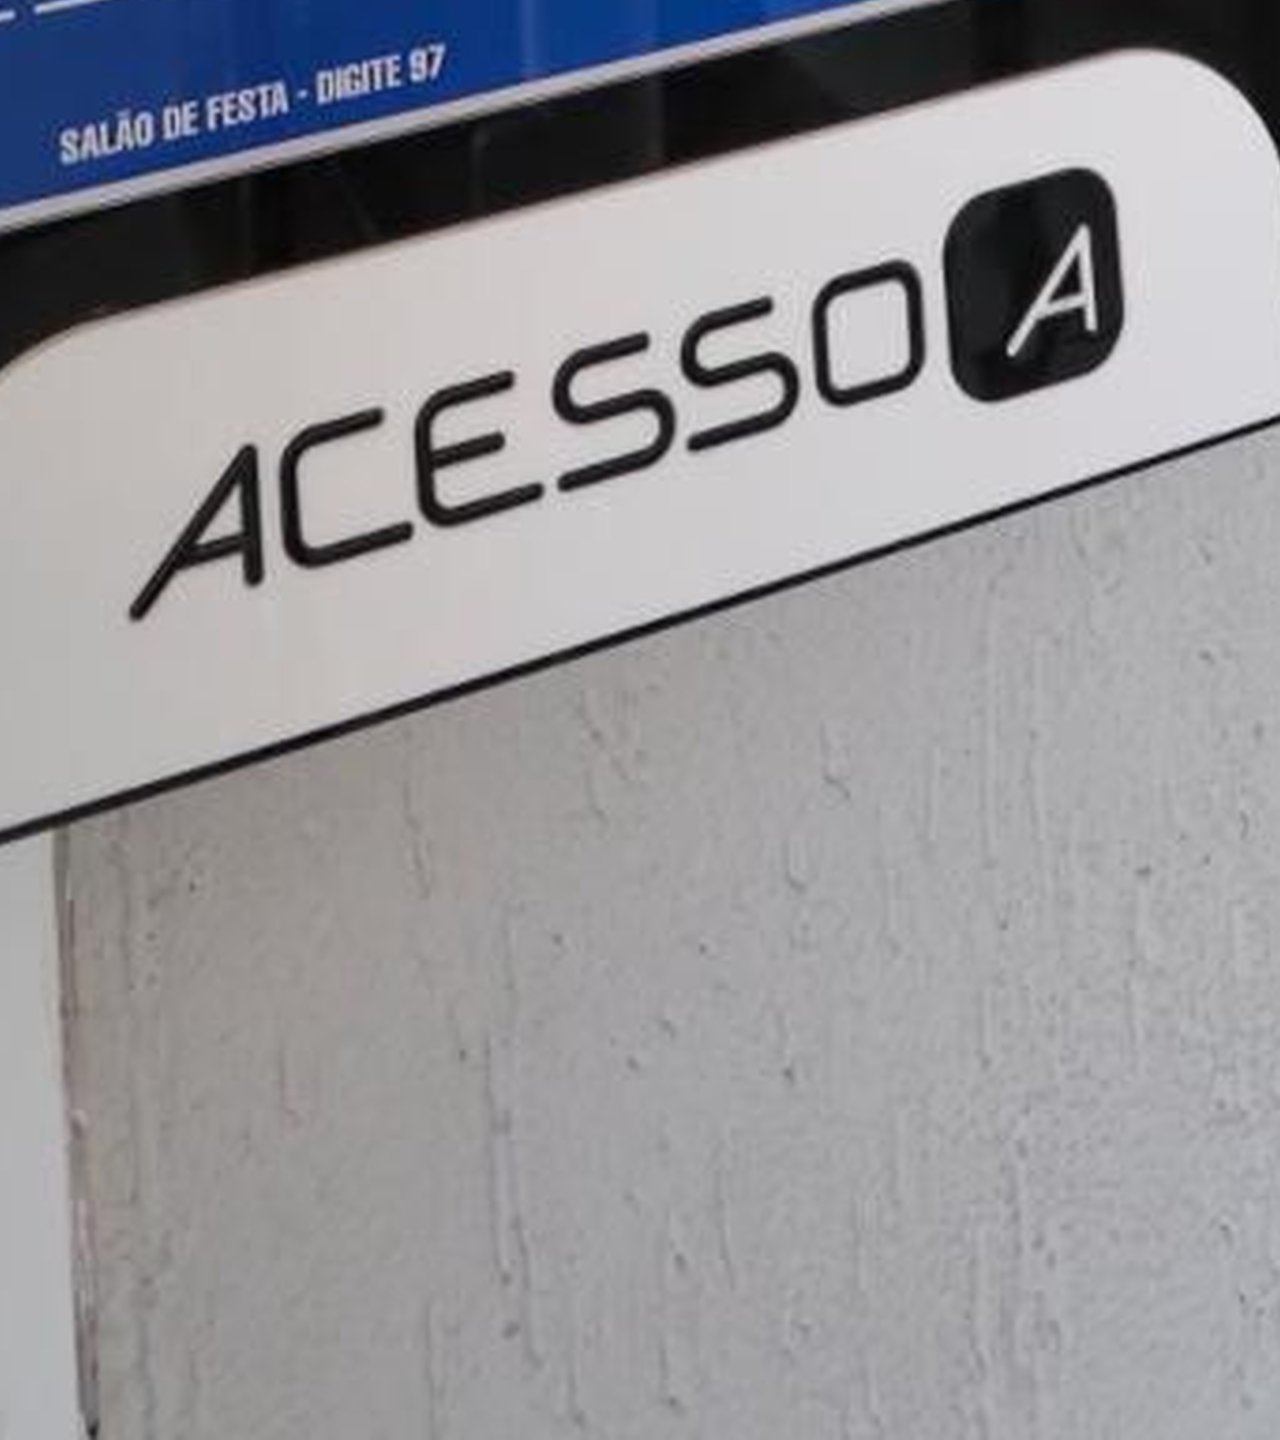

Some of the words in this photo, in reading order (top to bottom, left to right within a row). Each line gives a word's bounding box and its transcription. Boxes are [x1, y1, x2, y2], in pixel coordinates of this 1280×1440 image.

[60, 110, 153, 165] SALÃO
[162, 105, 199, 139] DE
[208, 82, 288, 128] FESTA
[318, 60, 401, 104] DIGITE
[409, 45, 445, 82] 97
[129, 259, 922, 621] ACESSO
